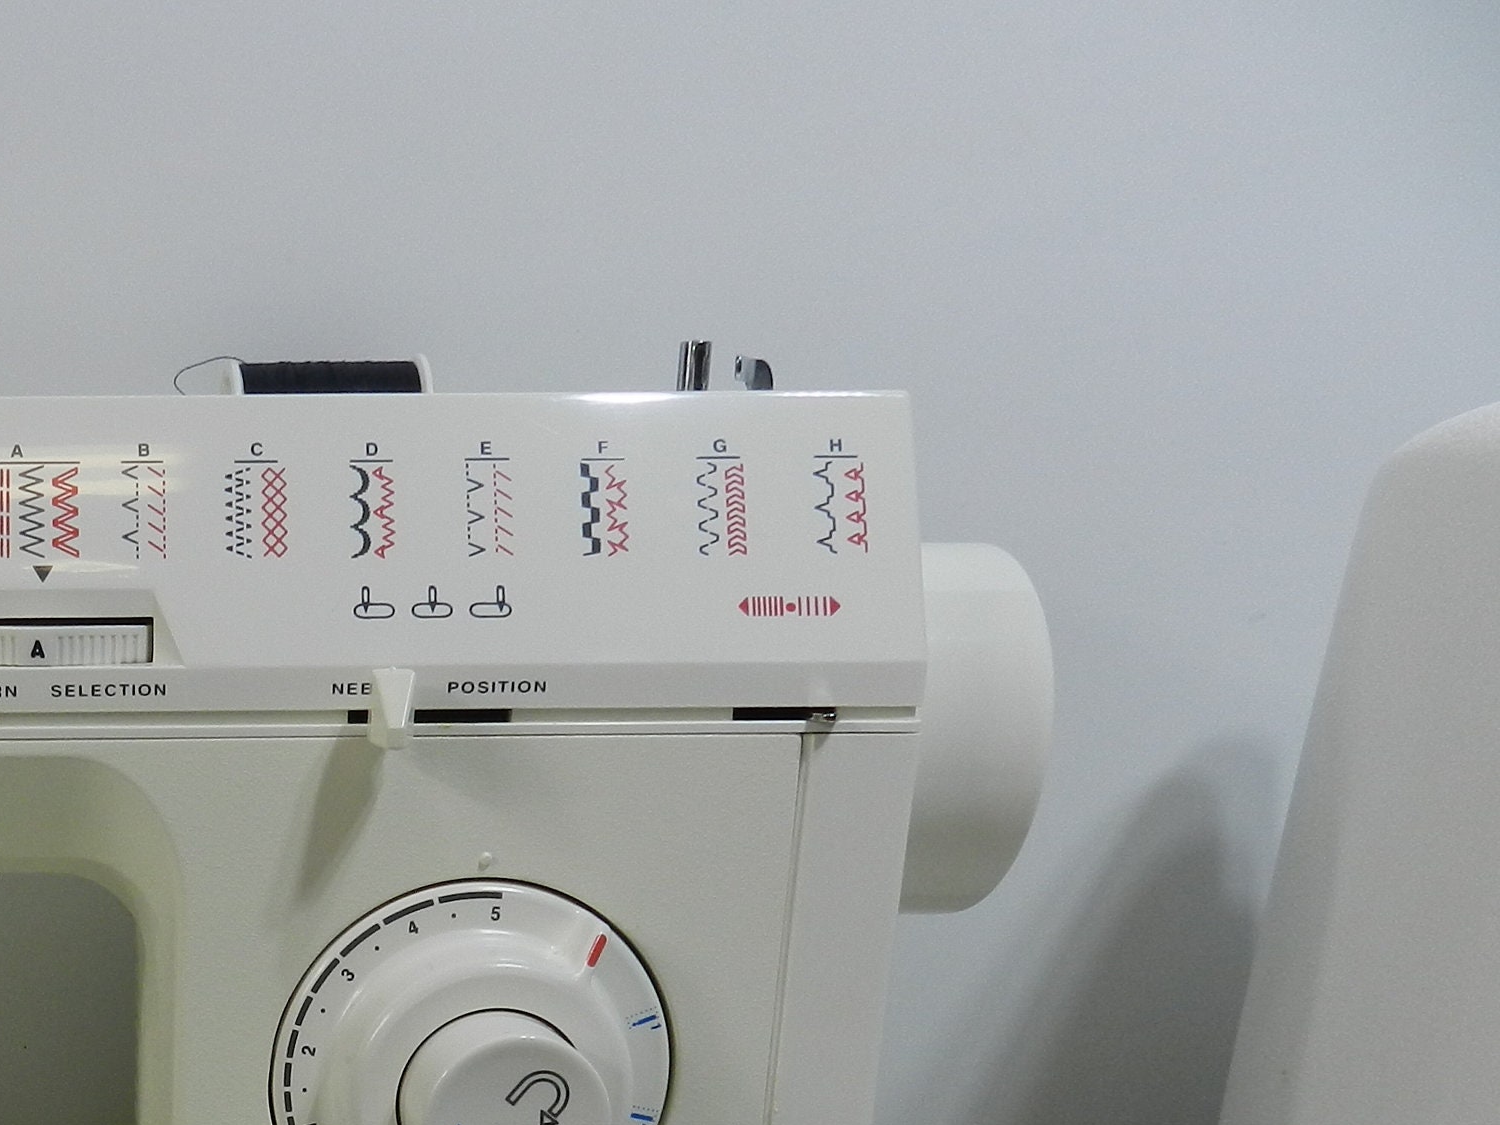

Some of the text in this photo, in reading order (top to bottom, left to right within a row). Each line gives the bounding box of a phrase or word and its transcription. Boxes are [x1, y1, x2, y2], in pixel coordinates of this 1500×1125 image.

[10, 443, 24, 459] A
[138, 442, 150, 458] B
[250, 442, 264, 458] C
[365, 442, 378, 458] D
[480, 440, 492, 456] E
[598, 440, 609, 455] F
[713, 438, 727, 454] G
[829, 438, 842, 453] H
[30, 639, 46, 659] A
[51, 683, 167, 698] SELECTION
[331, 680, 547, 696] NEE POSITION
[490, 906, 501, 921] 5
[408, 920, 419, 935] 4
[341, 968, 355, 982] 3
[301, 1044, 317, 1057] 2
